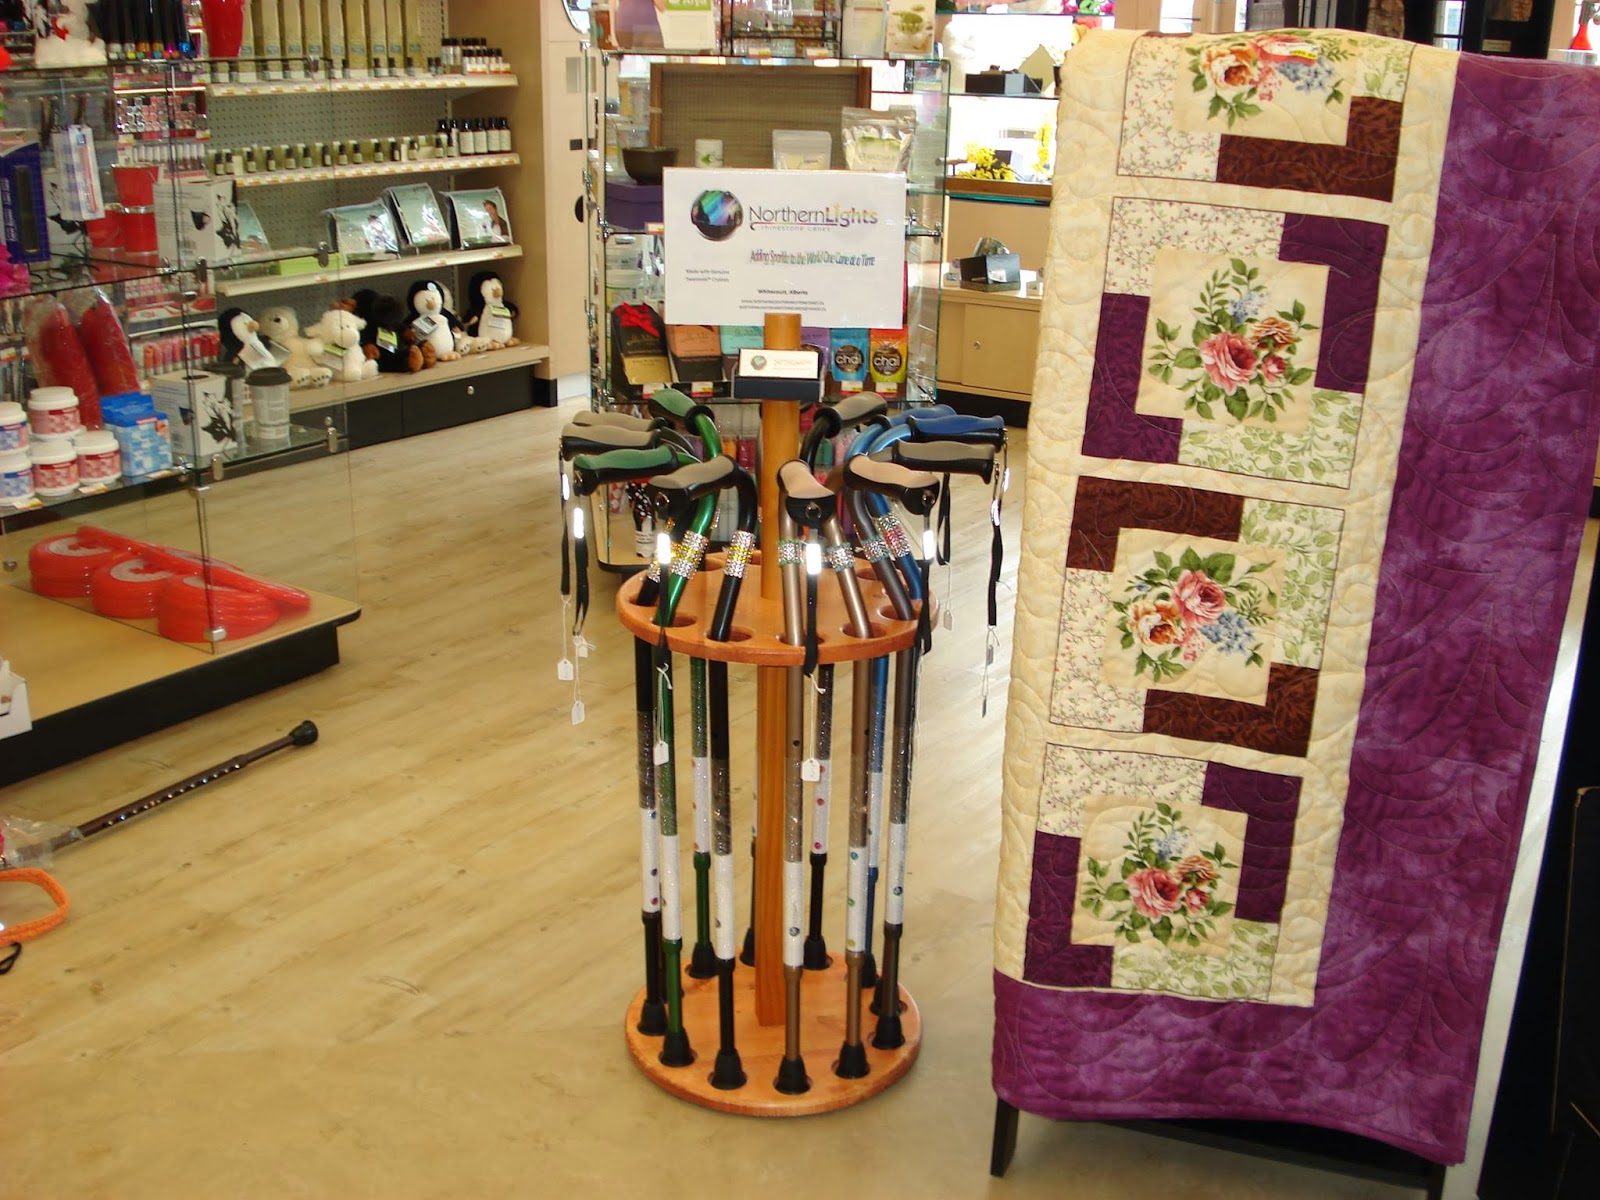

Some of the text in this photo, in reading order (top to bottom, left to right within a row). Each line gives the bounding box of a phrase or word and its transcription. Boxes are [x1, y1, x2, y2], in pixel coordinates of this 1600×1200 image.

[750, 249, 769, 265] Adding
[861, 254, 876, 266] Time
[835, 353, 862, 365] chai
[873, 355, 901, 367] chai
